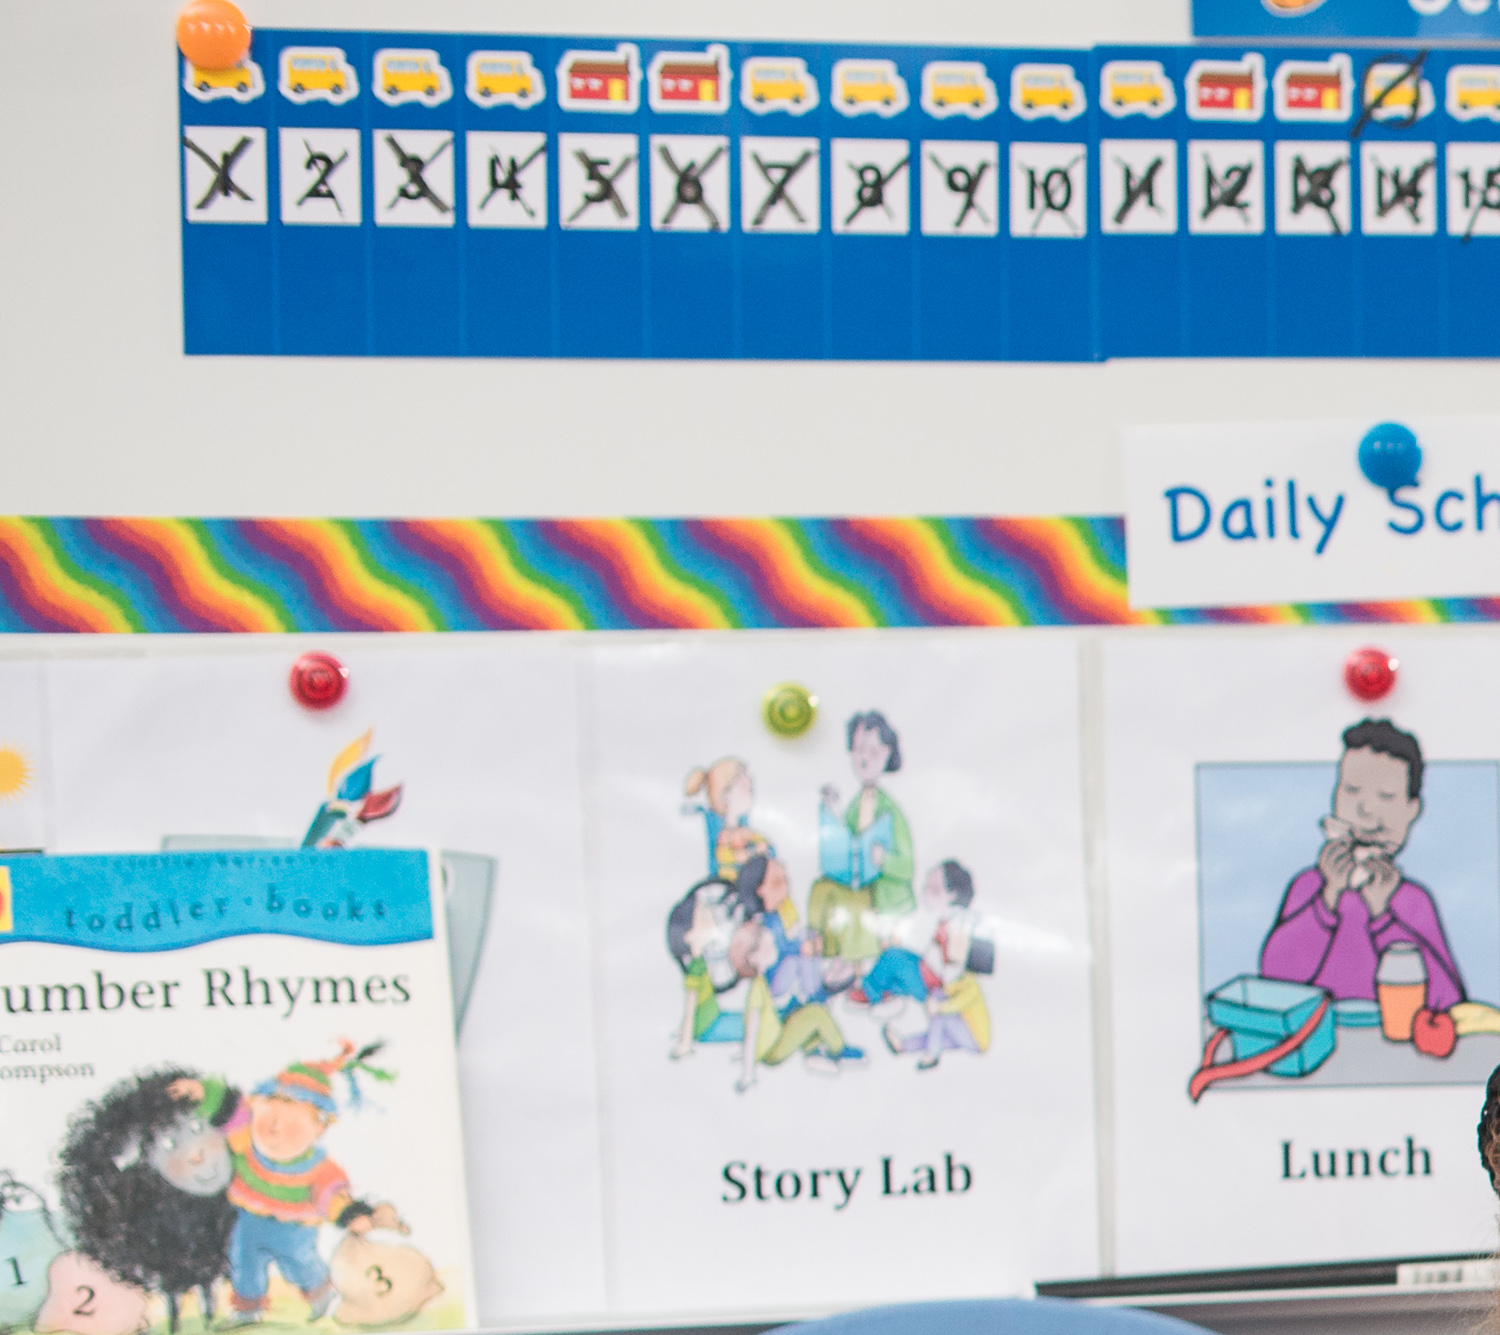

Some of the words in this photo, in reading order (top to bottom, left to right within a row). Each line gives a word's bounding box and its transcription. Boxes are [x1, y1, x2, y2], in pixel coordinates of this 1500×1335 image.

[1162, 477, 1346, 556] Daily
[66, 896, 228, 931] toddler
[266, 883, 388, 922] books
[200, 965, 412, 1020] Rhymes
[721, 1157, 861, 1213] Story
[879, 1151, 974, 1198] Lab
[1279, 1134, 1435, 1182] Lunch
[6, 1256, 28, 1287] 1
[365, 1264, 393, 1297] 3
[73, 1284, 96, 1317] 2
